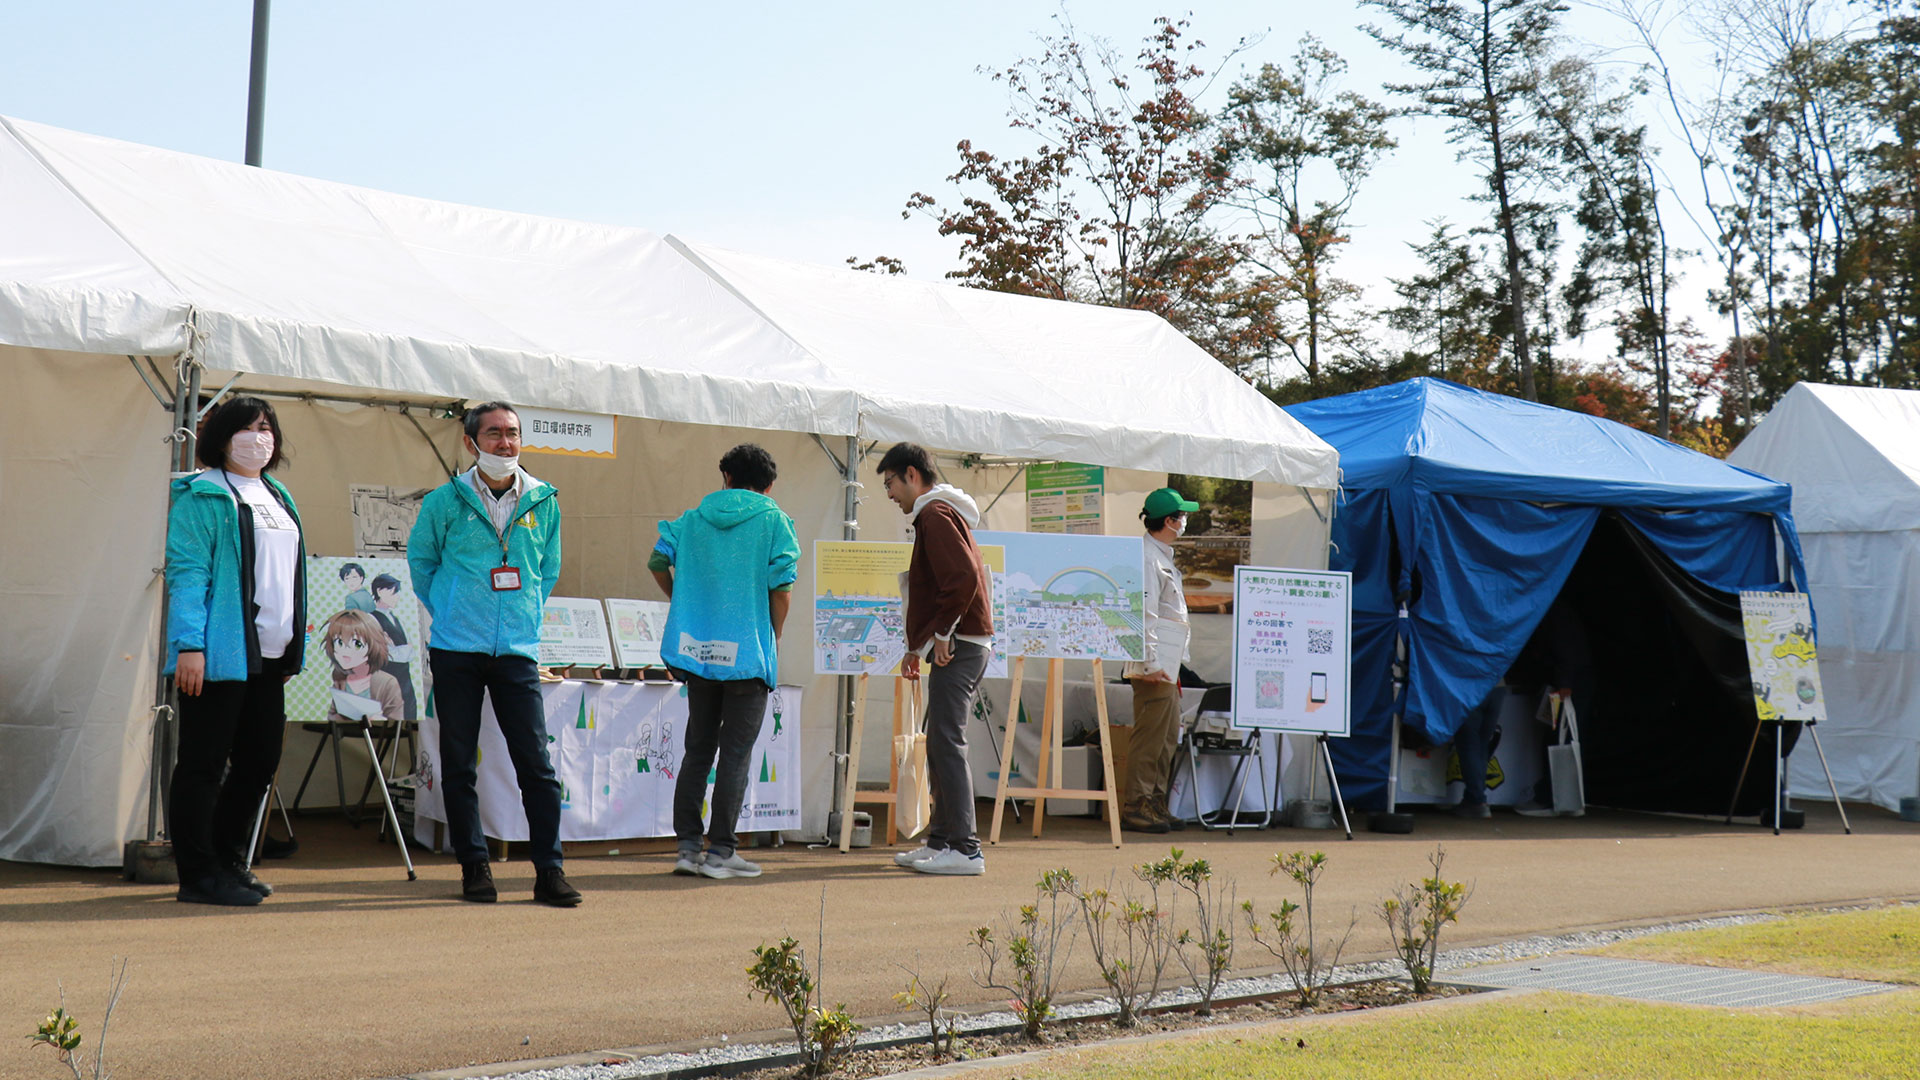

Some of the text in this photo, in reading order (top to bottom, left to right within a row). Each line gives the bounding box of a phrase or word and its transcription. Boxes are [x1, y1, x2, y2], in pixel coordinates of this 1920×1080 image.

[533, 420, 592, 437] 国立環境研究所
[1243, 576, 1342, 590] 大熊町の自然環境に関する
[1248, 586, 1339, 599] アンケート調査のお願い
[1253, 610, 1287, 618] QRコード
[1247, 619, 1294, 628] からの回答で
